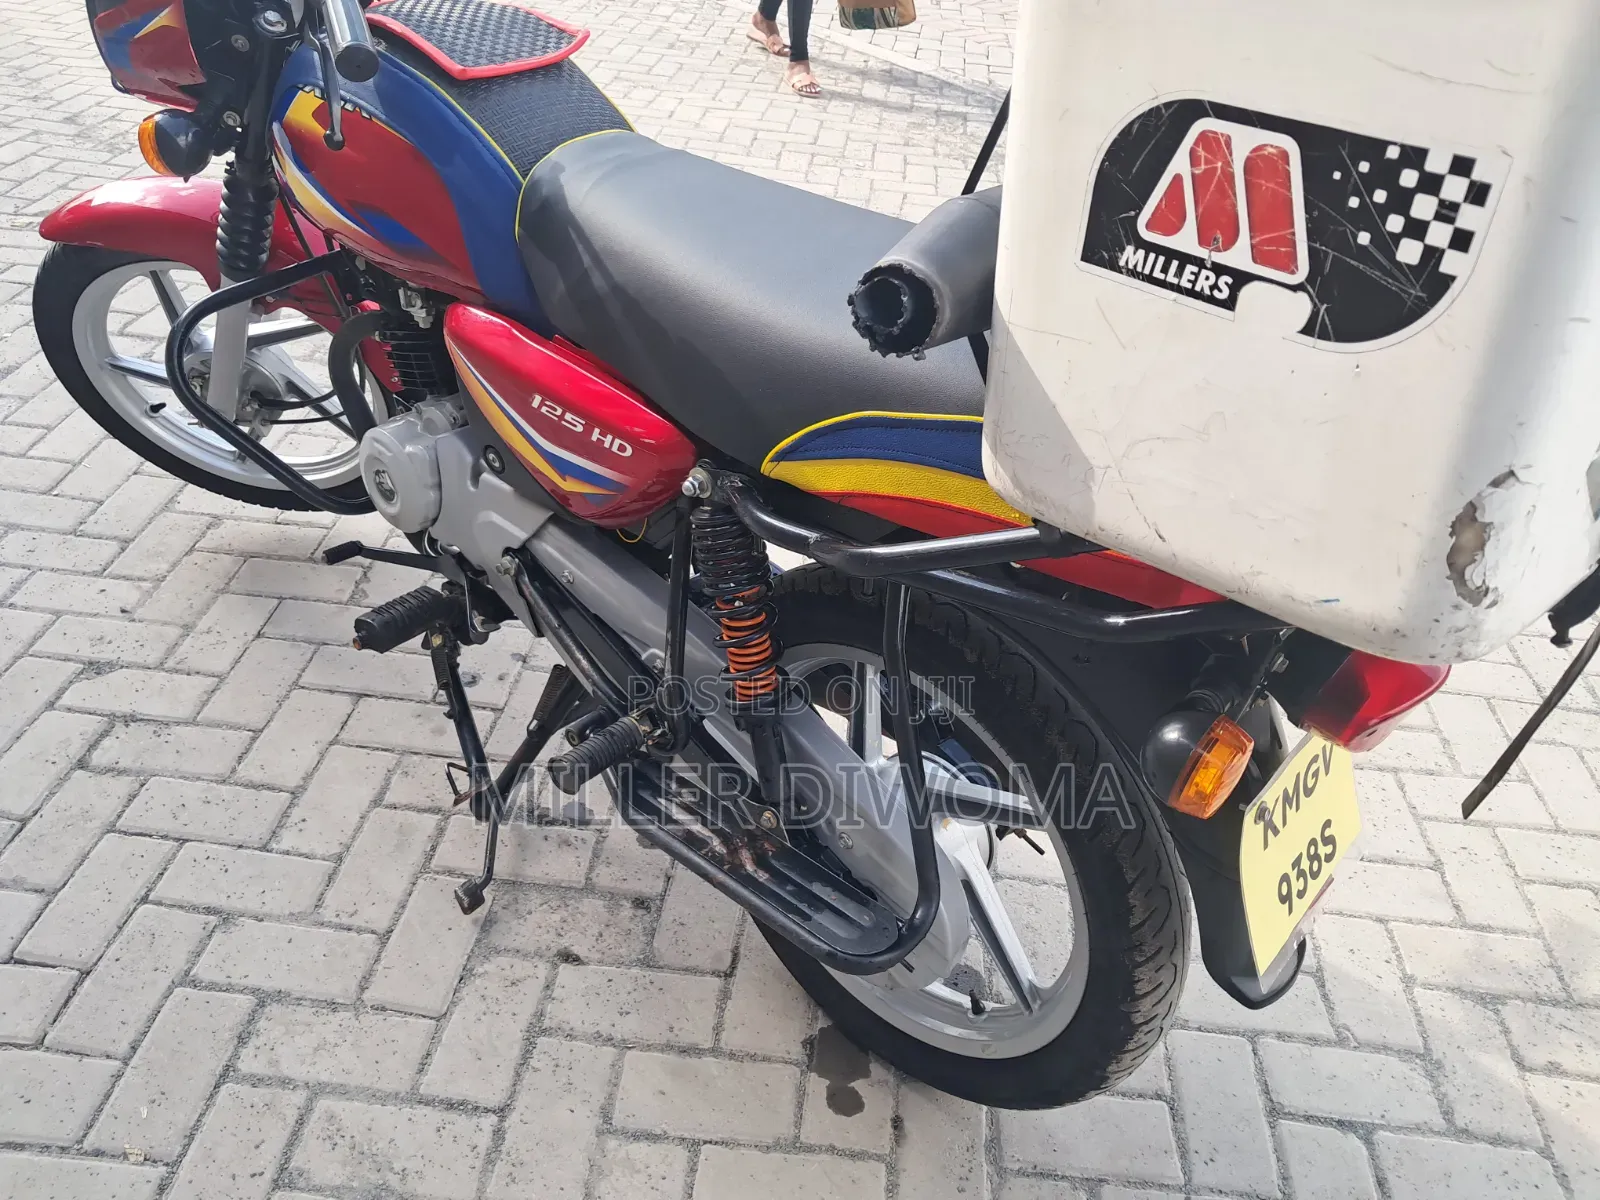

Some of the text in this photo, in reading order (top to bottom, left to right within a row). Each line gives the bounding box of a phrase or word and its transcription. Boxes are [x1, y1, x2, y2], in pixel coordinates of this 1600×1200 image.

[1118, 245, 1234, 300] MILLERS
[530, 394, 633, 457] 125 HD
[1259, 743, 1334, 852] KMGV
[1278, 818, 1337, 917] 938S
